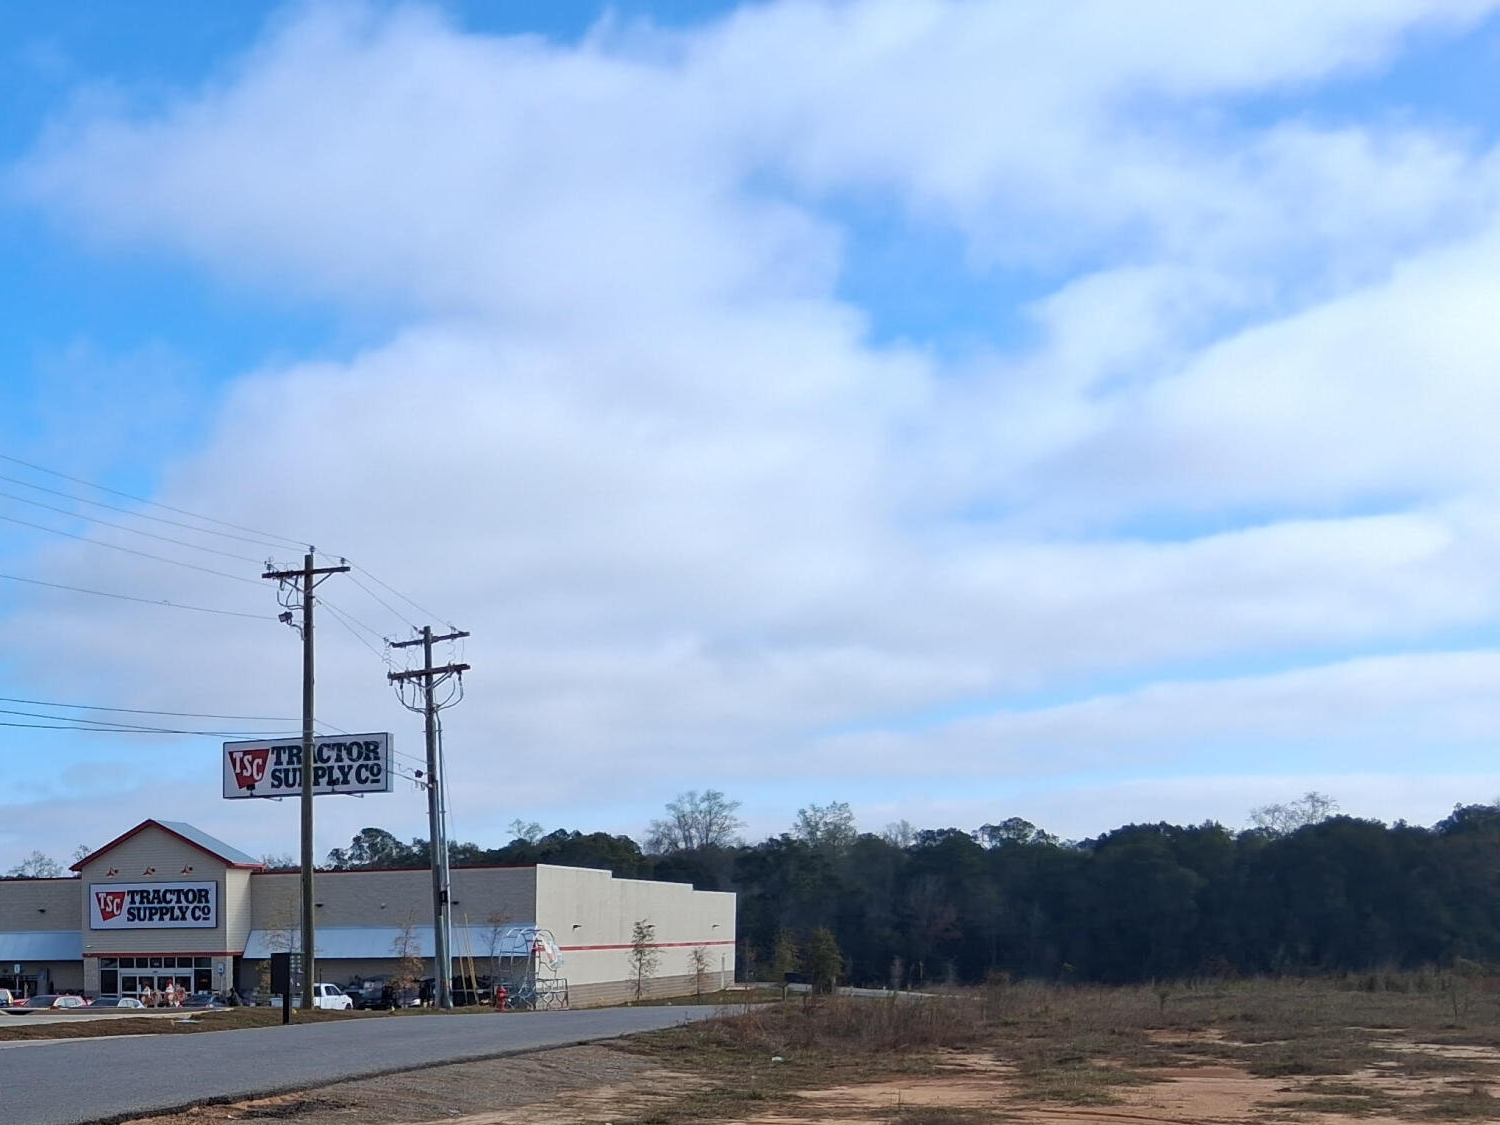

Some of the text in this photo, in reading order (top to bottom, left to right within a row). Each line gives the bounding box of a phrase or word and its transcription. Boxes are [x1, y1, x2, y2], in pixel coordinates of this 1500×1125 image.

[271, 740, 381, 766] TRCTOR
[233, 751, 263, 780] TSC
[271, 765, 353, 788] SUPLY
[98, 892, 121, 915] TSC
[126, 888, 210, 905] TRACTOR
[126, 905, 190, 922] SUPPLY
